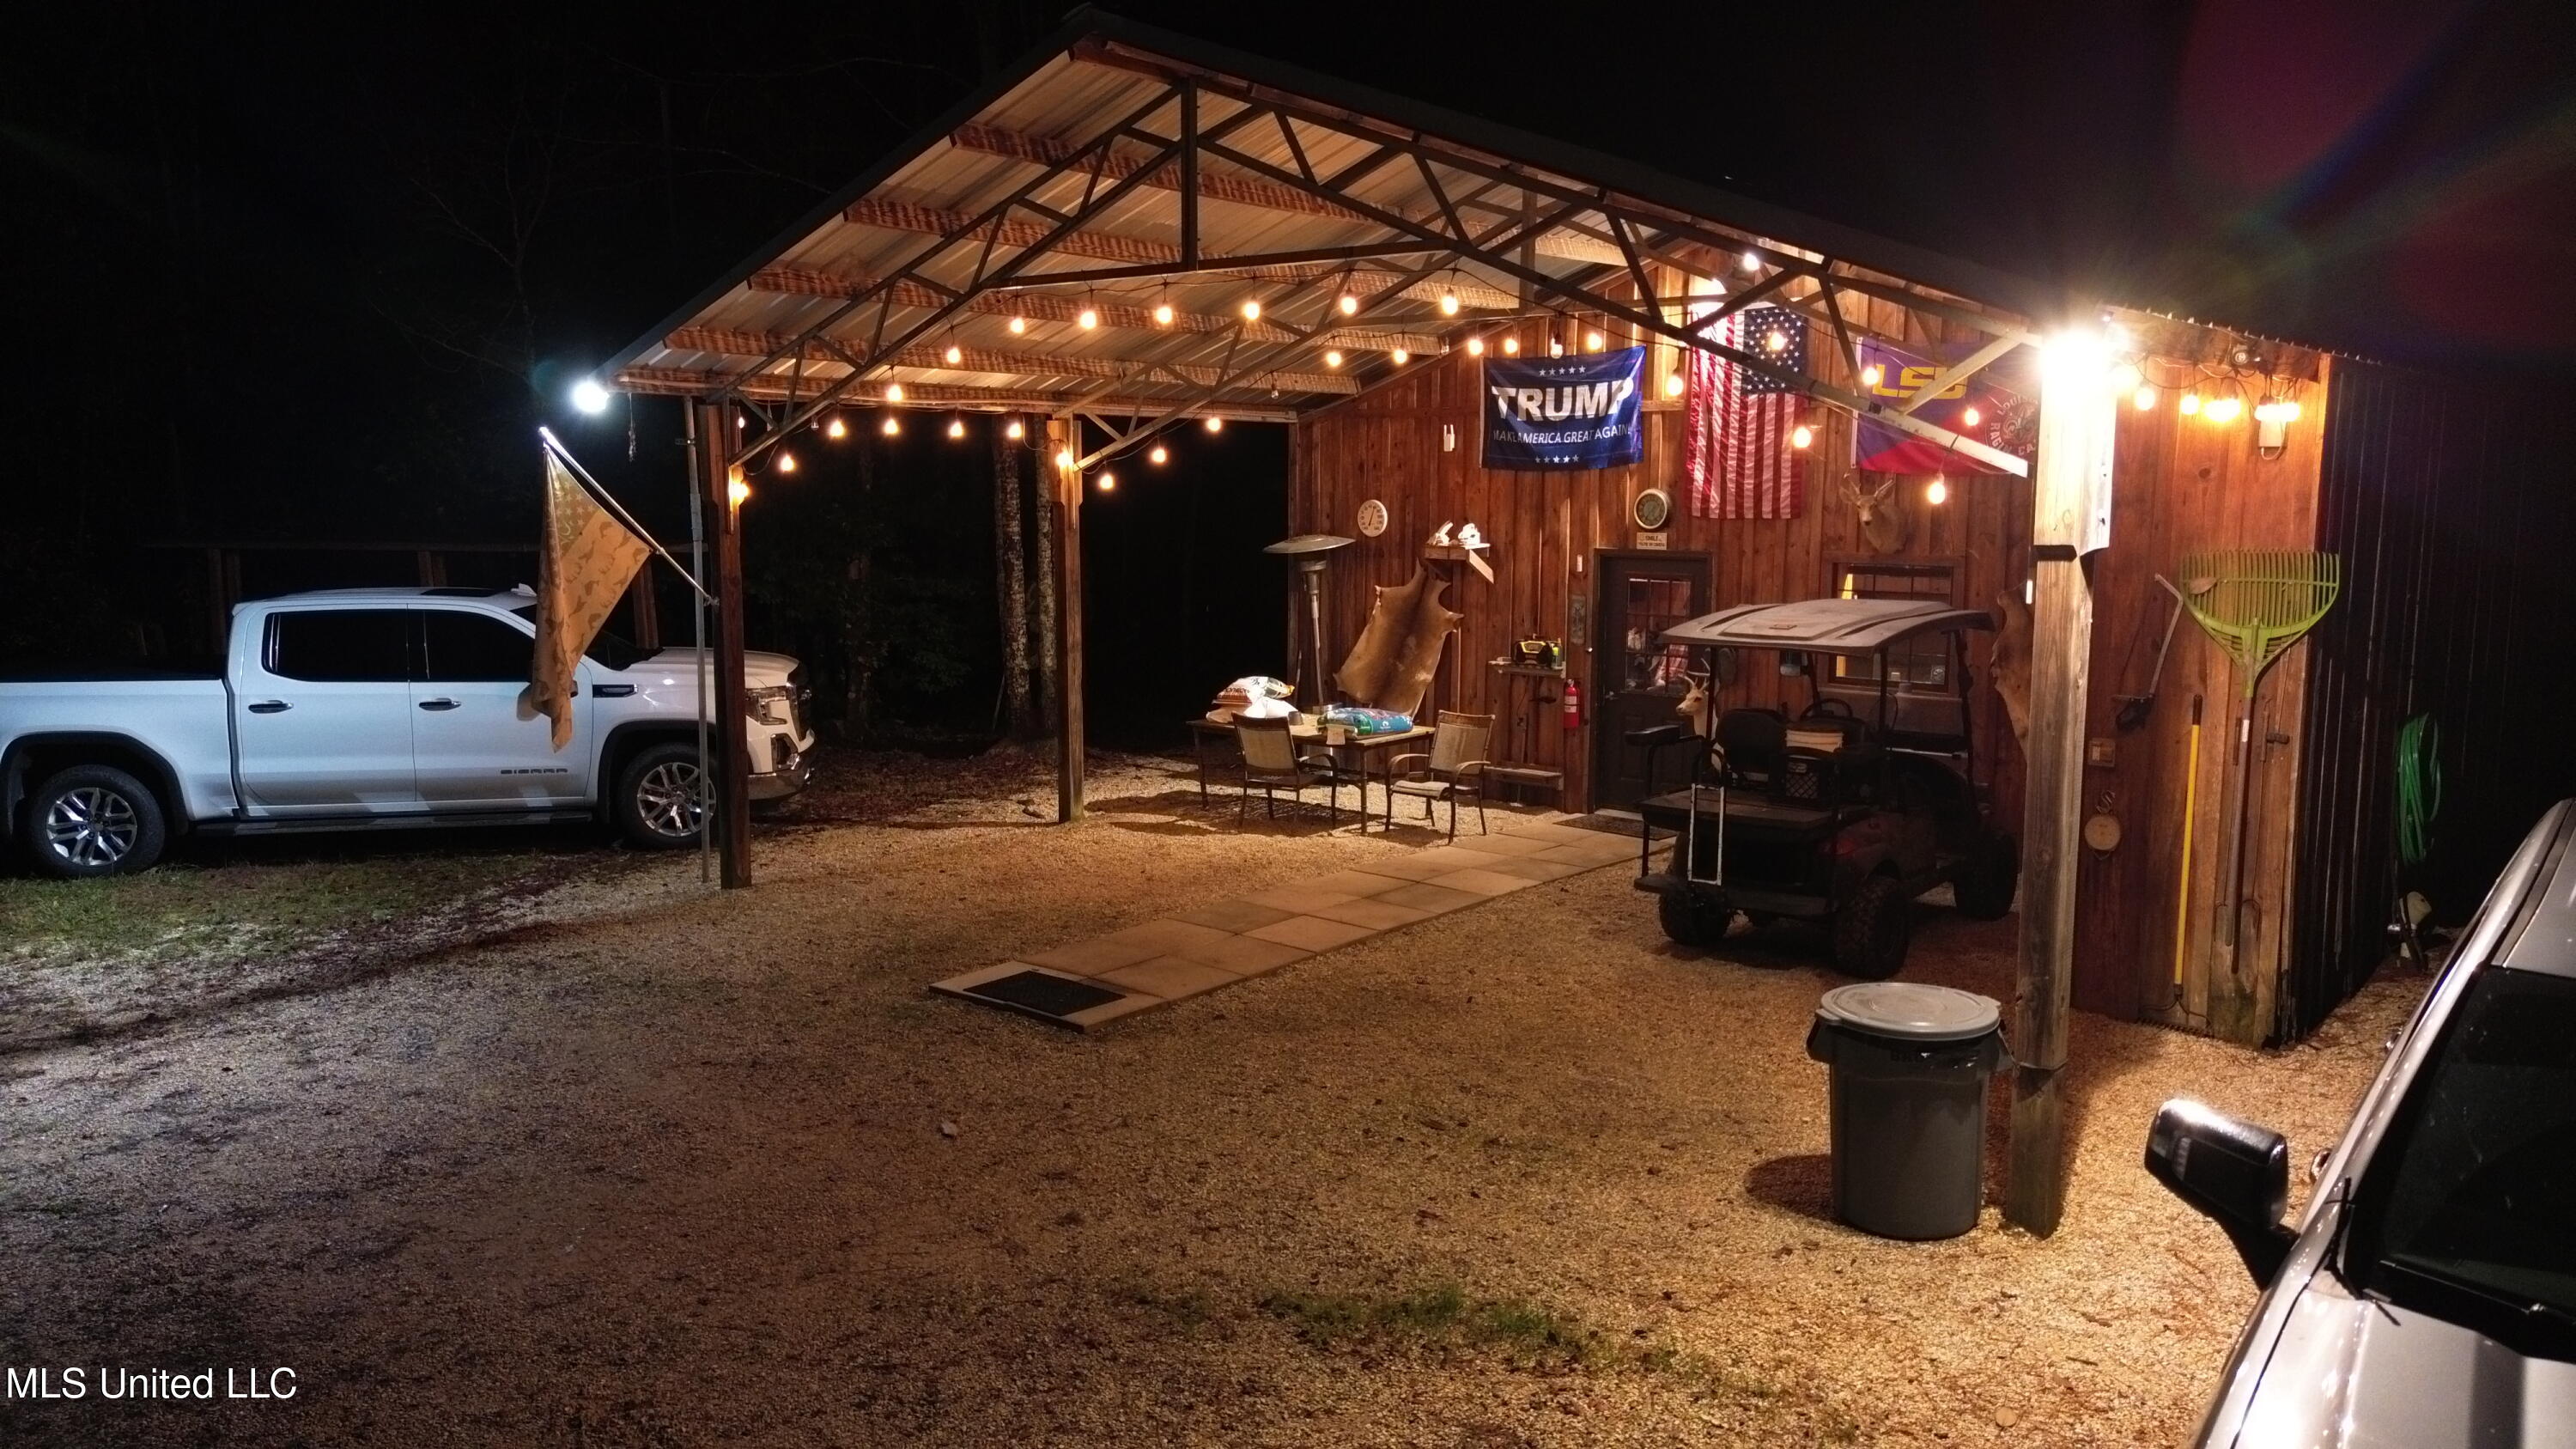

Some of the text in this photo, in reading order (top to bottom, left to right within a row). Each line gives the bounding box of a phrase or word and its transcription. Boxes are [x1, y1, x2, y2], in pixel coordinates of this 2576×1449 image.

[1492, 376, 1634, 422] TRUMP
[1517, 432, 1561, 444] AMERICA
[1564, 429, 1594, 443] GREAT
